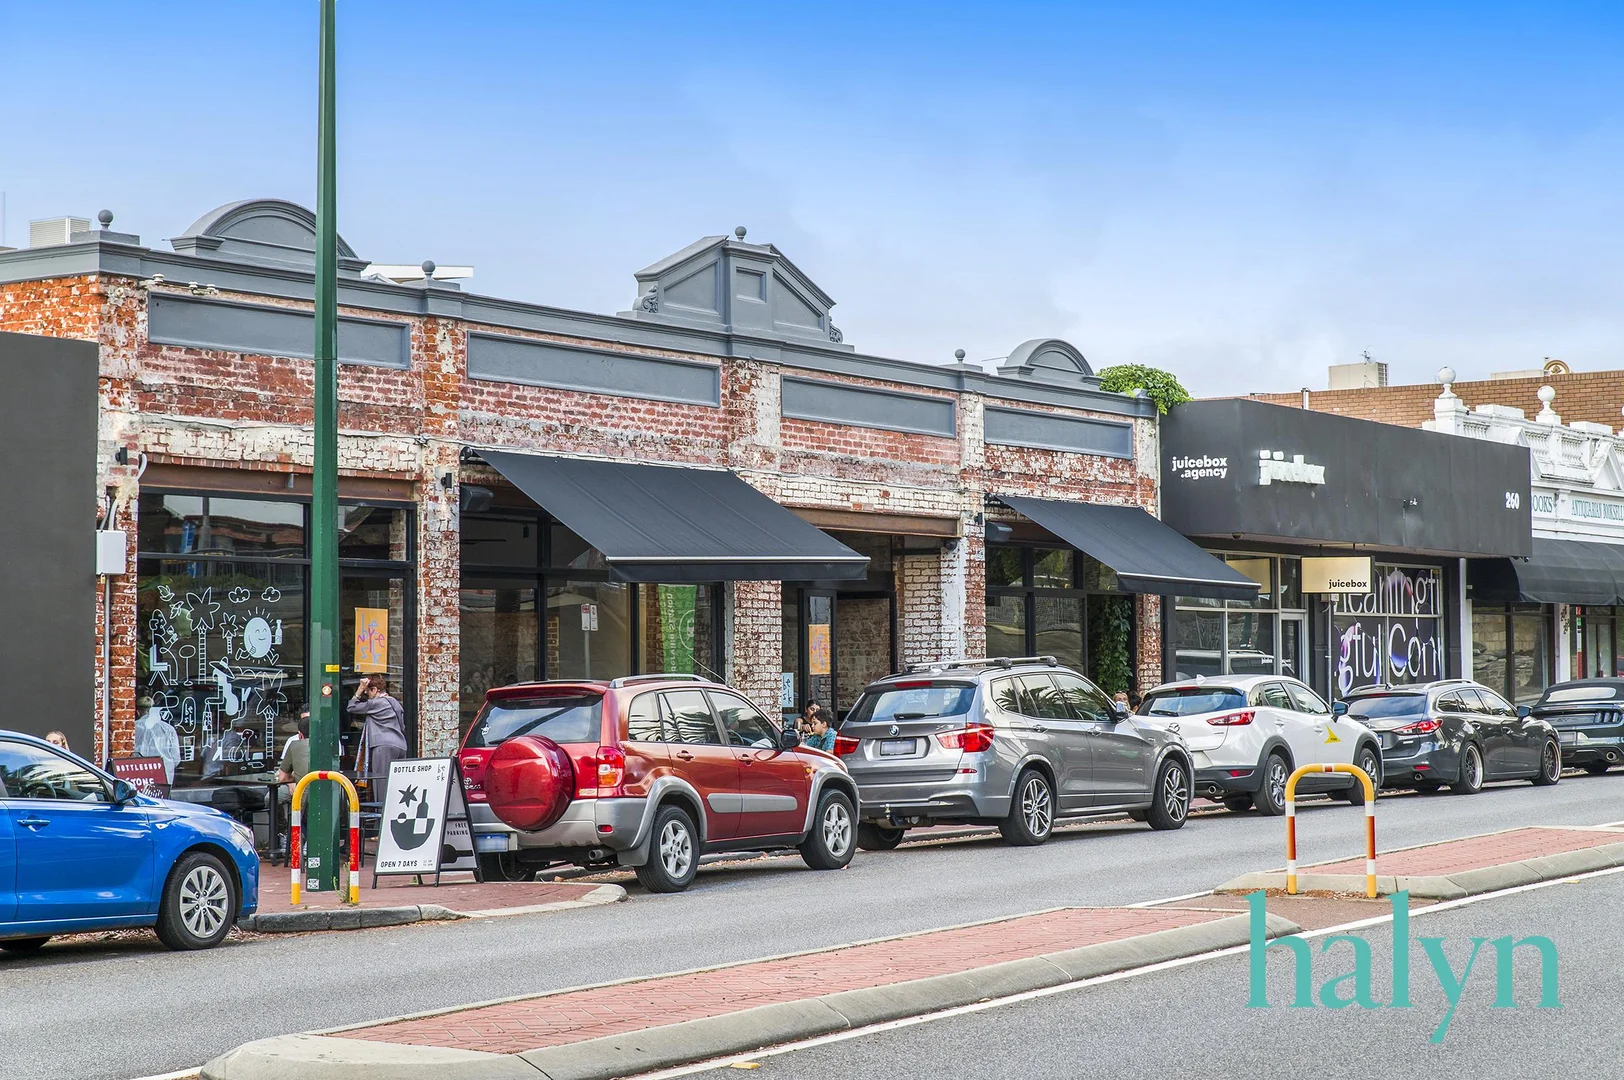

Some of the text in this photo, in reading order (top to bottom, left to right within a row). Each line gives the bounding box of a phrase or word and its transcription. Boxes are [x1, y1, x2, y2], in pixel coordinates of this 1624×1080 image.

[1171, 455, 1228, 471] juicebox
[1180, 466, 1228, 480] .agency
[1505, 492, 1520, 510] 260
[1328, 579, 1368, 589] juicebox
[116, 762, 162, 772] BOTTLESHOP
[393, 764, 432, 773] BOTTLE SHOP
[380, 860, 396, 868] OPEN
